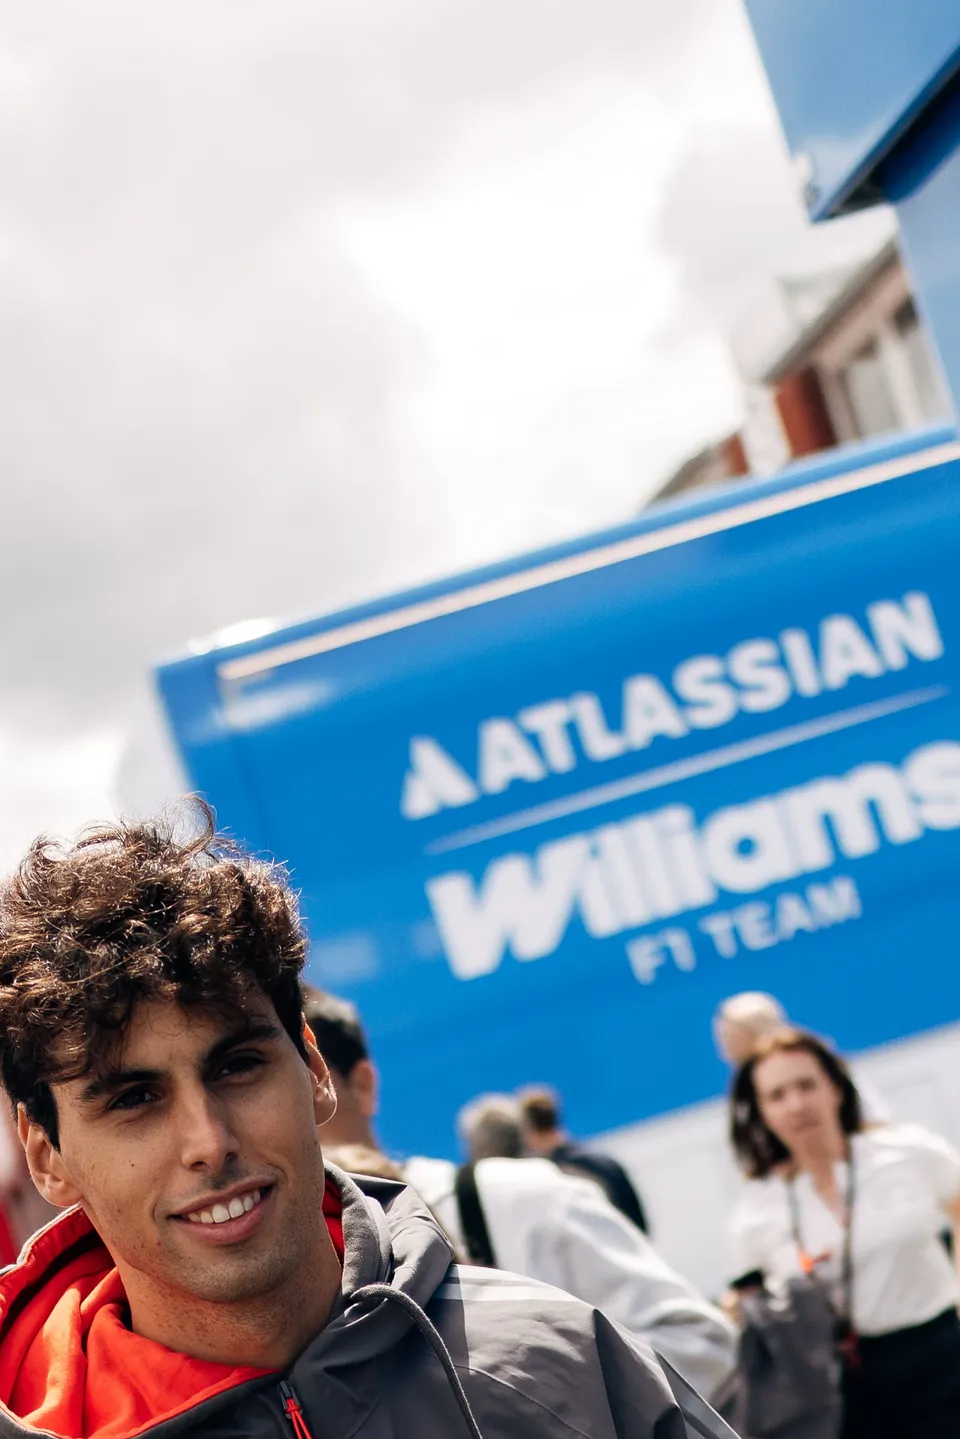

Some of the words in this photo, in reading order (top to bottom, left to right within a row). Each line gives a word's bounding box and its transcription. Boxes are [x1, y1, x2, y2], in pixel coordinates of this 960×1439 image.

[479, 591, 944, 795] ATLASSIAN
[427, 740, 960, 981] Williams
[626, 926, 697, 985] F1
[700, 876, 863, 959] TEAM
